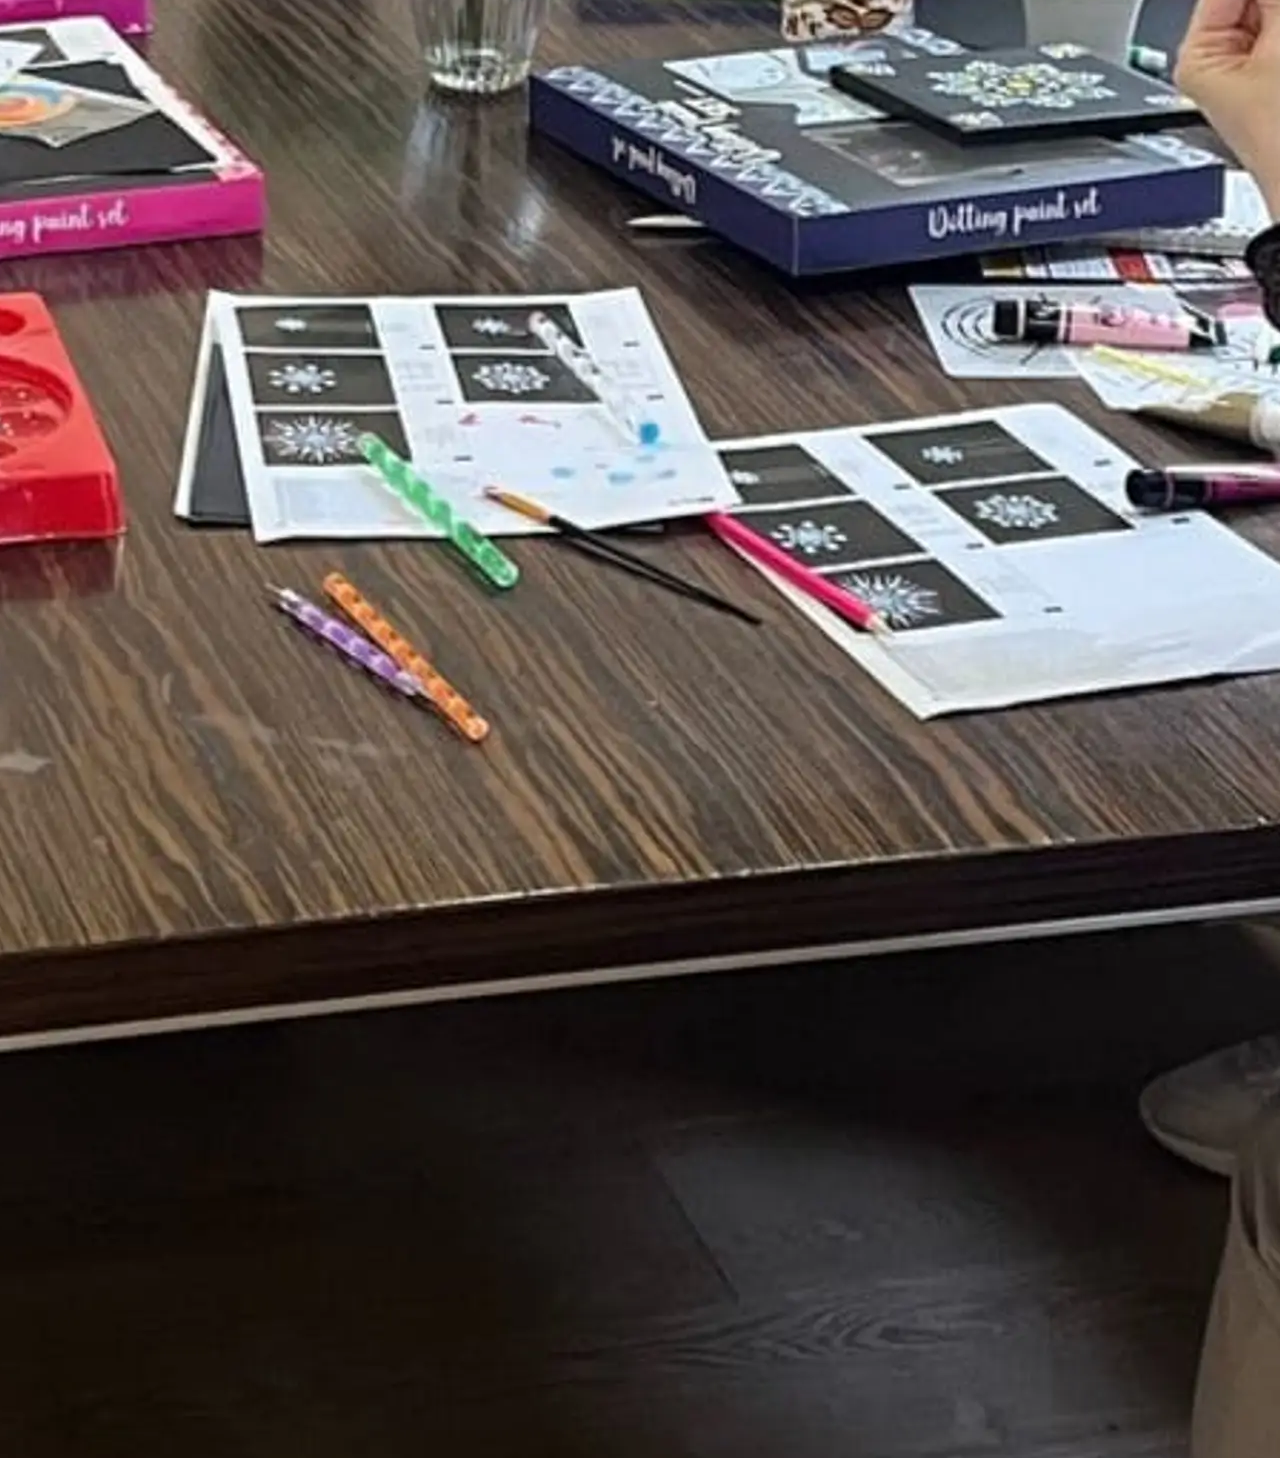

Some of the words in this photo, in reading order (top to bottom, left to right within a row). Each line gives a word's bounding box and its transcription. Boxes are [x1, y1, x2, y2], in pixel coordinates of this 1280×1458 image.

[32, 202, 94, 244] paint
[928, 201, 1008, 239] Dotting
[1013, 190, 1069, 237] paint
